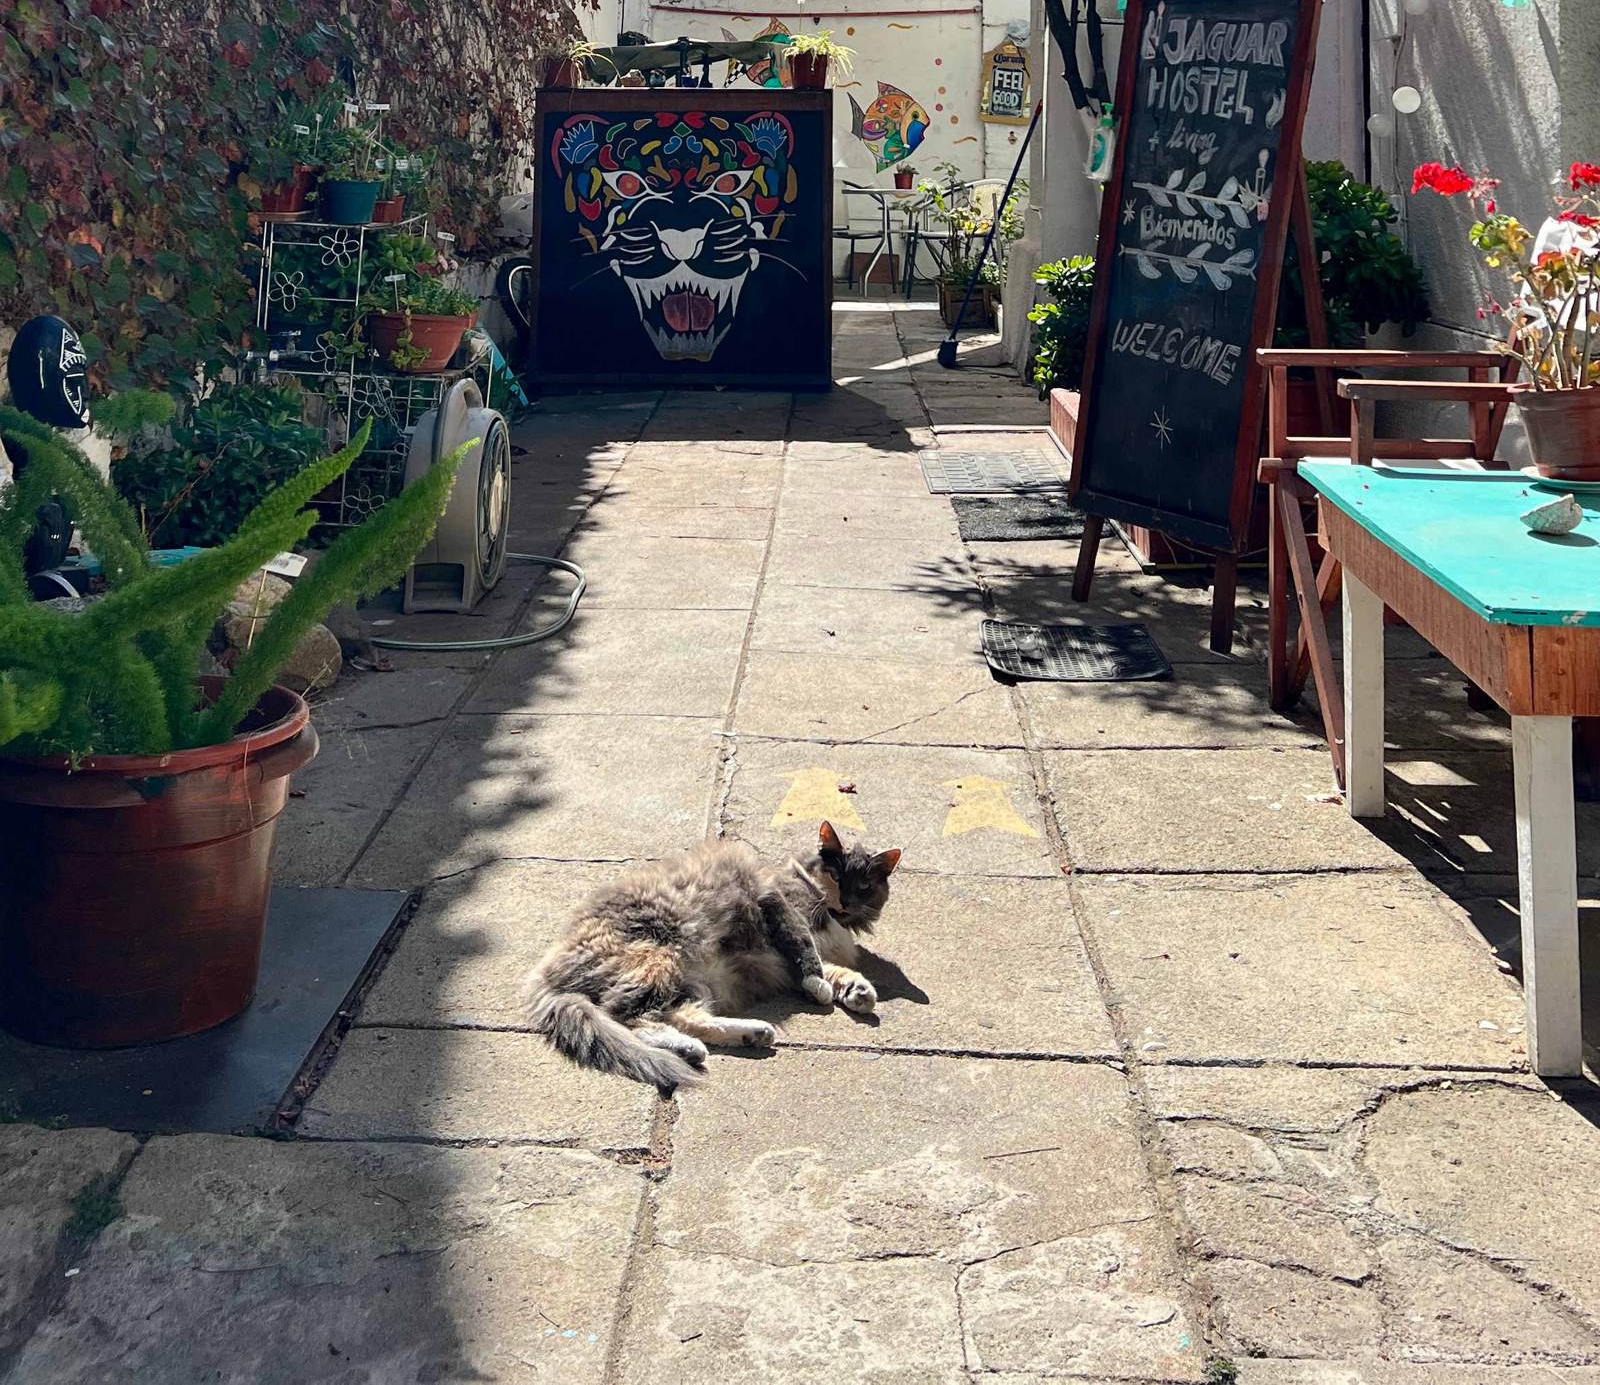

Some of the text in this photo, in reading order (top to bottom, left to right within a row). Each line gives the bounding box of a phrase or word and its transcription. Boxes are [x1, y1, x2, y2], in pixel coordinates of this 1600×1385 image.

[1162, 17, 1288, 67] JAGUAR
[992, 90, 1019, 106] GOOD
[994, 70, 1023, 90] FEEL
[1147, 66, 1254, 125] HOSTEL
[1139, 205, 1237, 251] Bienvenidos
[1112, 318, 1242, 386] WELCOME
